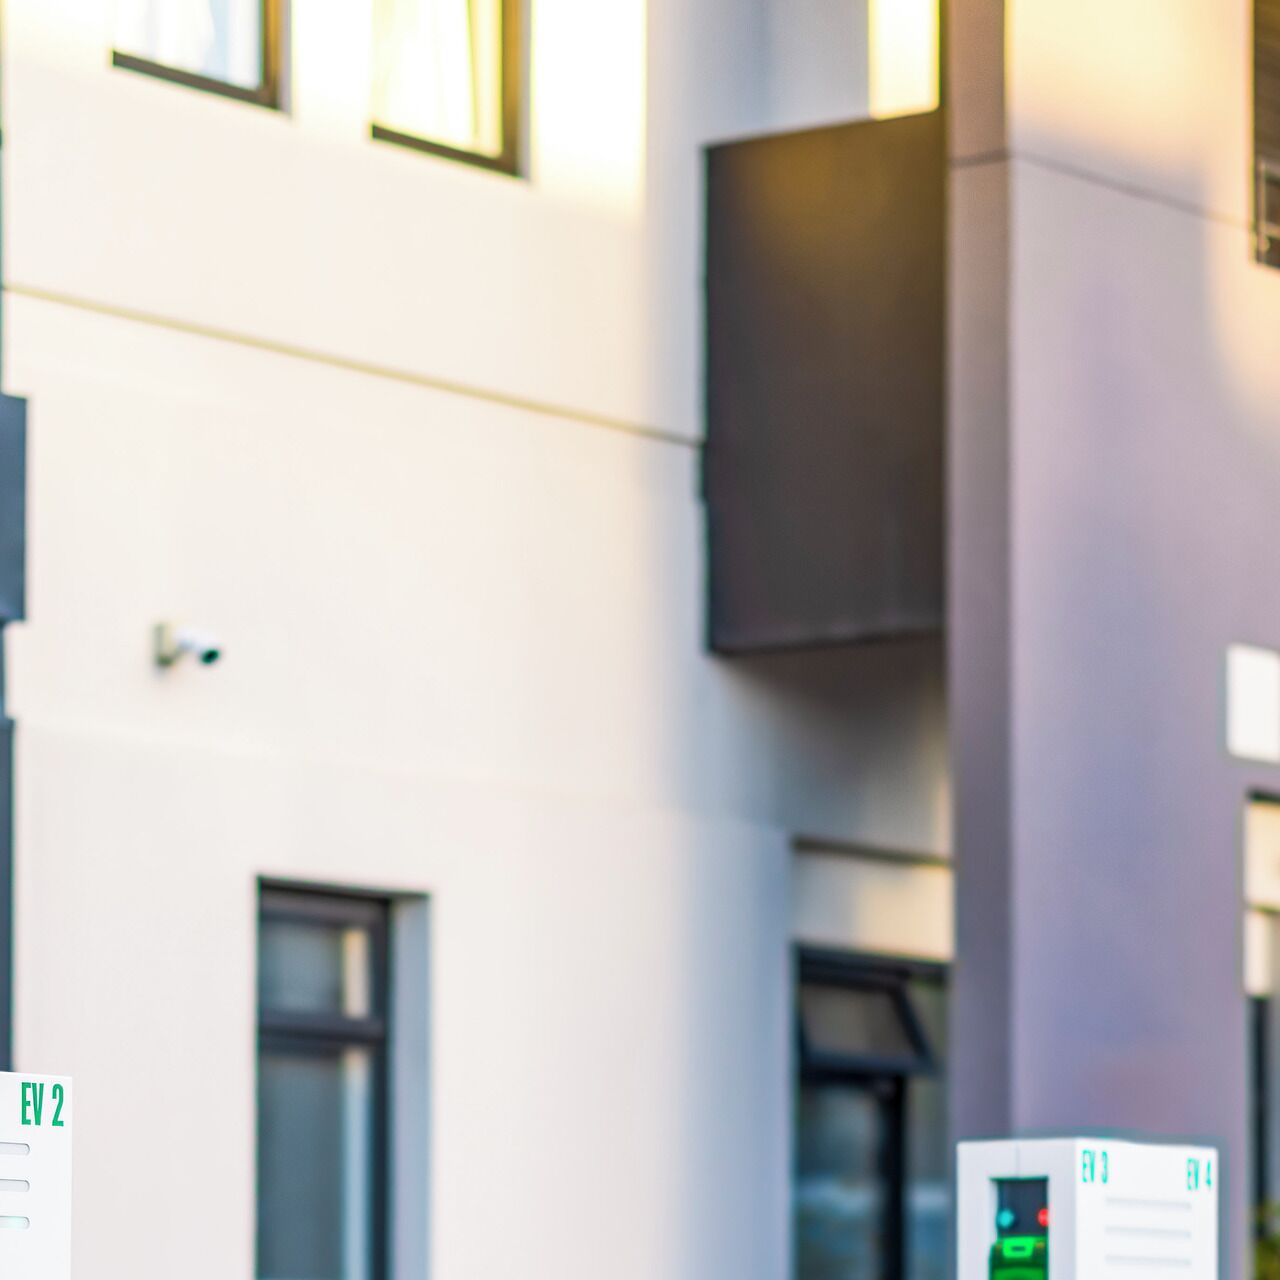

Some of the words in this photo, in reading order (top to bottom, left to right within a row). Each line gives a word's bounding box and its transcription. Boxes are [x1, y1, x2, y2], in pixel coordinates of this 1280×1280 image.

[21, 1082, 45, 1126] EV
[51, 1083, 65, 1127] 2
[1082, 1150, 1095, 1183] EV
[1187, 1158, 1200, 1191] EV
